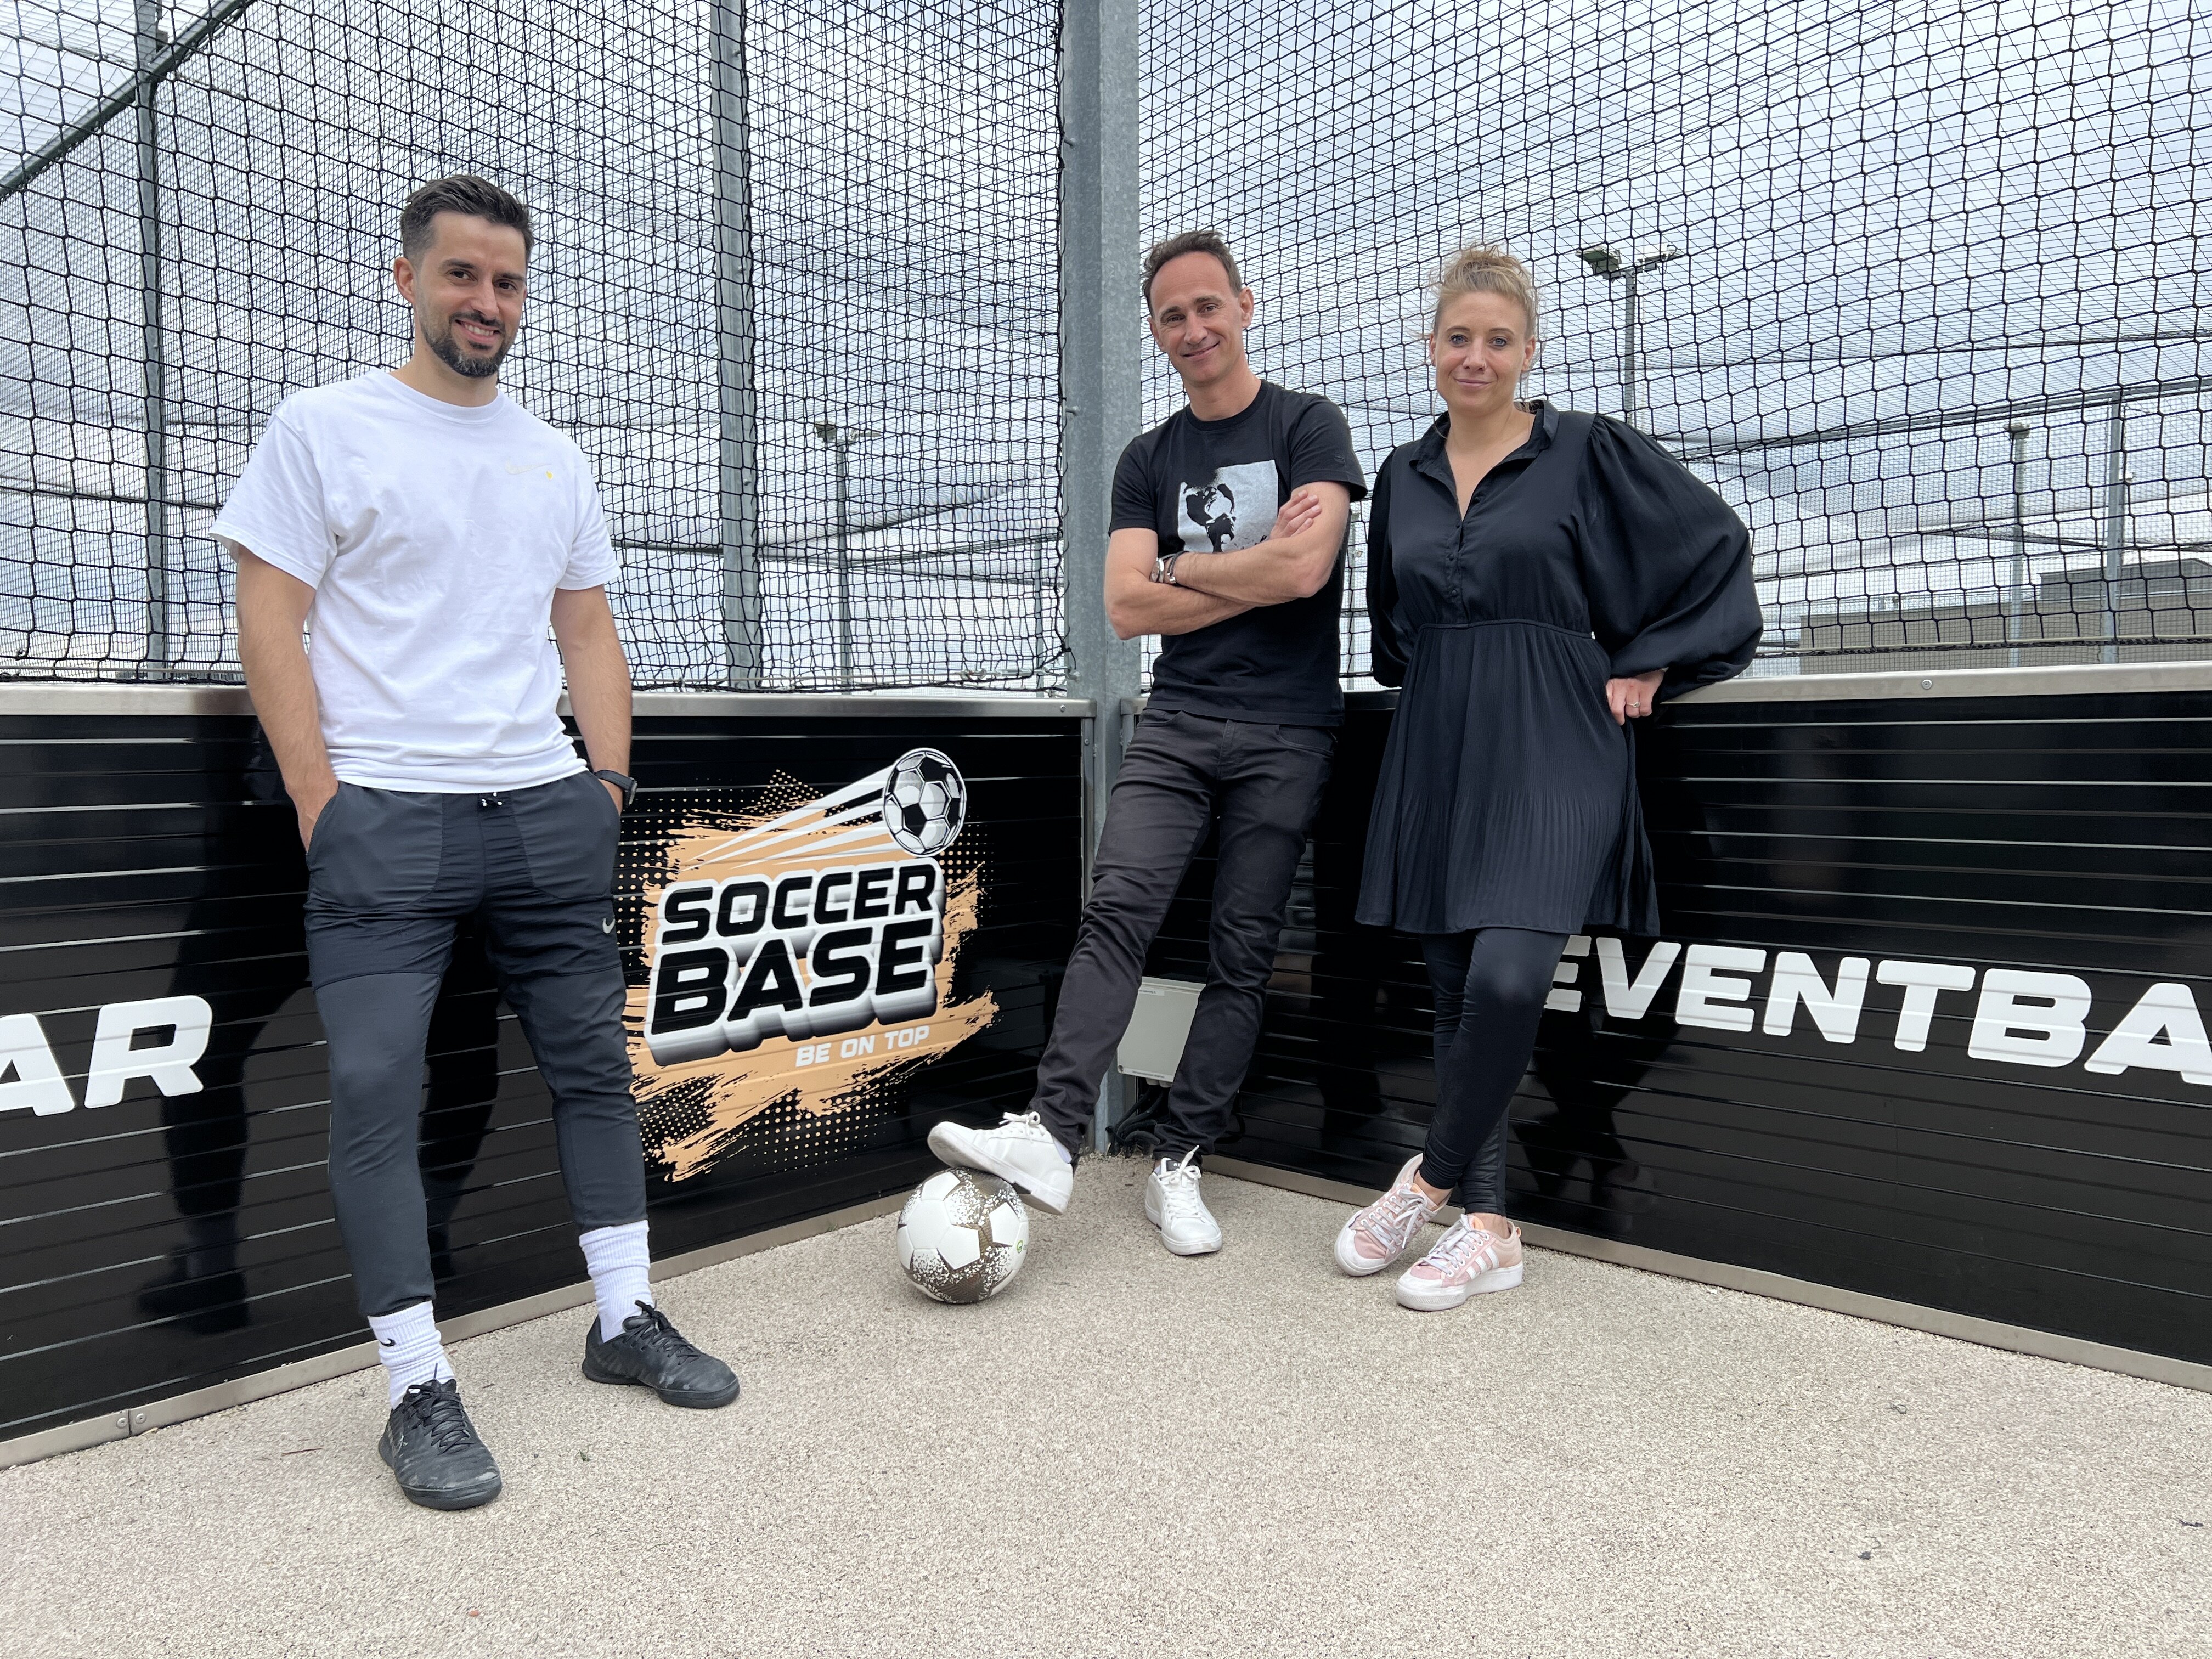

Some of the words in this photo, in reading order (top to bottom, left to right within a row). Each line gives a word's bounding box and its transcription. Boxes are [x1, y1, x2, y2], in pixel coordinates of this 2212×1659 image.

[661, 863, 937, 946] SOCCER
[651, 917, 934, 1036] BASE
[795, 1043, 832, 1068] BE
[840, 1035, 876, 1059] ON
[884, 1025, 930, 1050] TOP
